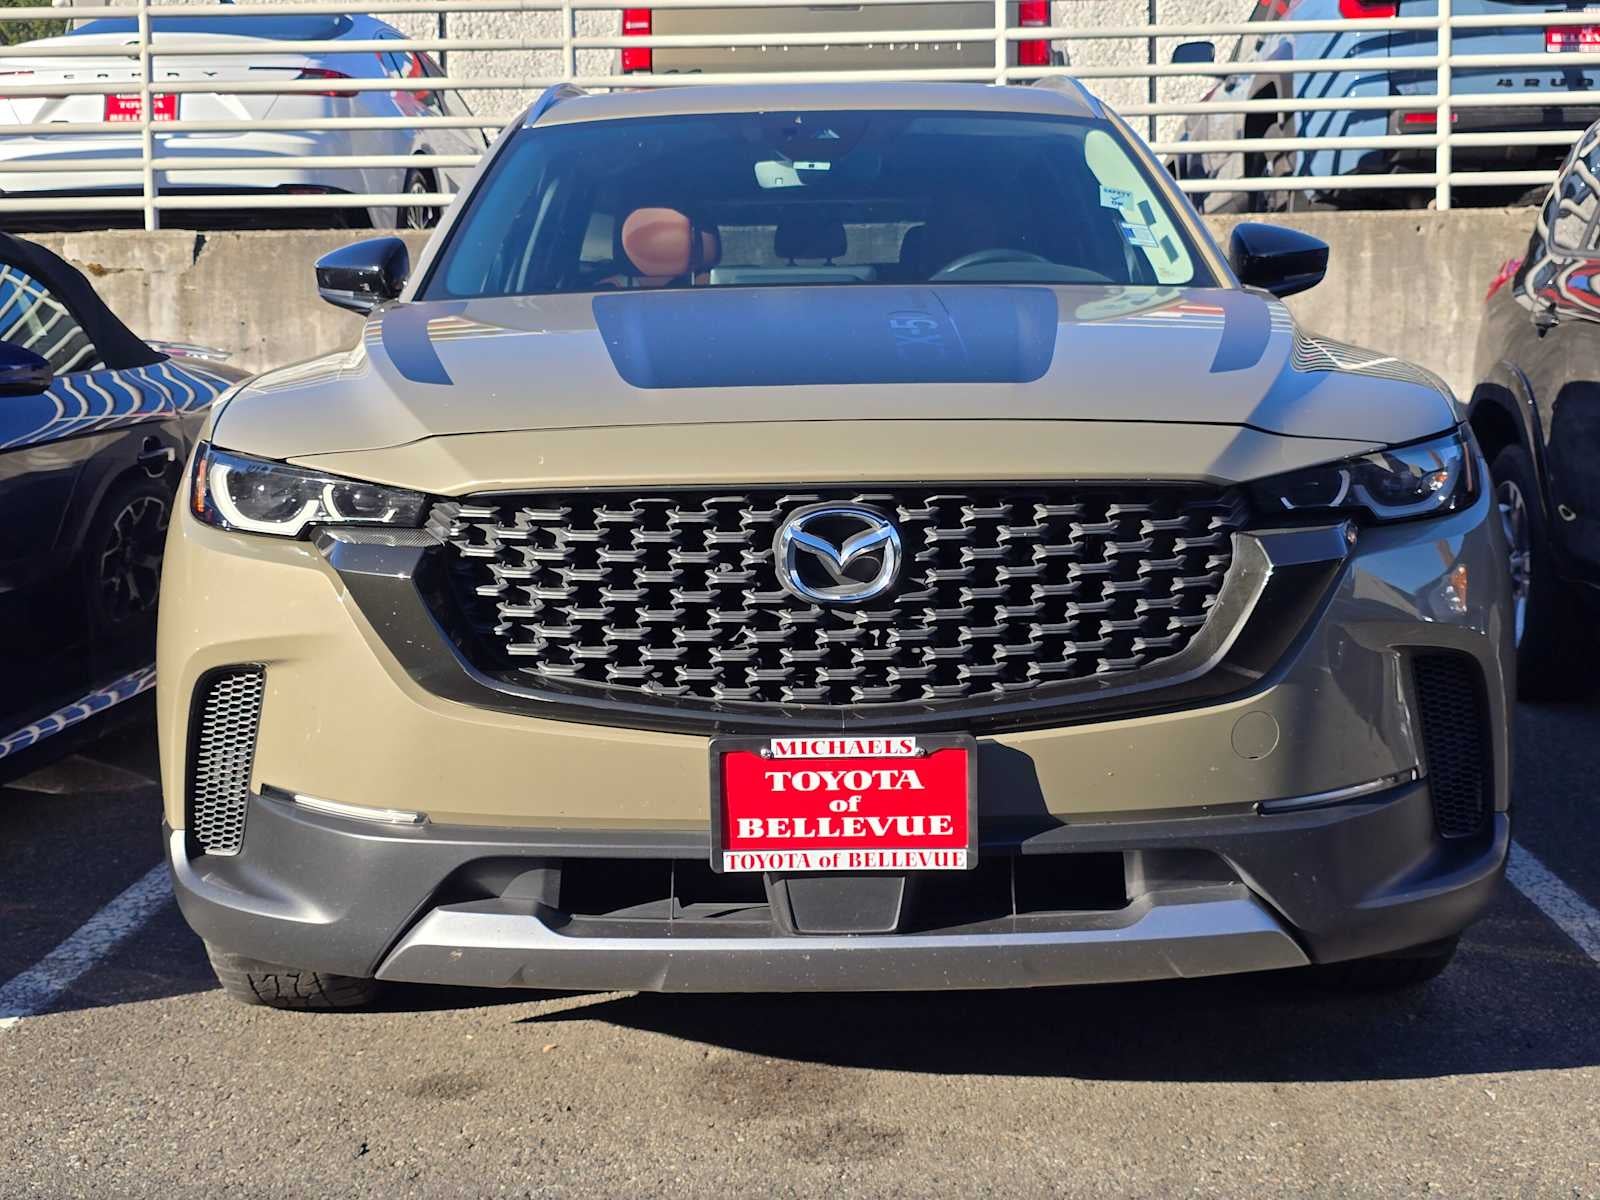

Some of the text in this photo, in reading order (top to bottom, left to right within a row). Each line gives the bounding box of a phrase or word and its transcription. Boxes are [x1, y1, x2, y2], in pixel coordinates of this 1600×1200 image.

[774, 740, 913, 756] MICHAELS
[765, 769, 925, 792] TOYOTA
[828, 795, 862, 813] of
[736, 815, 954, 839] BELLEVUE
[726, 850, 965, 870] TOYOTA of BELLEVUE
